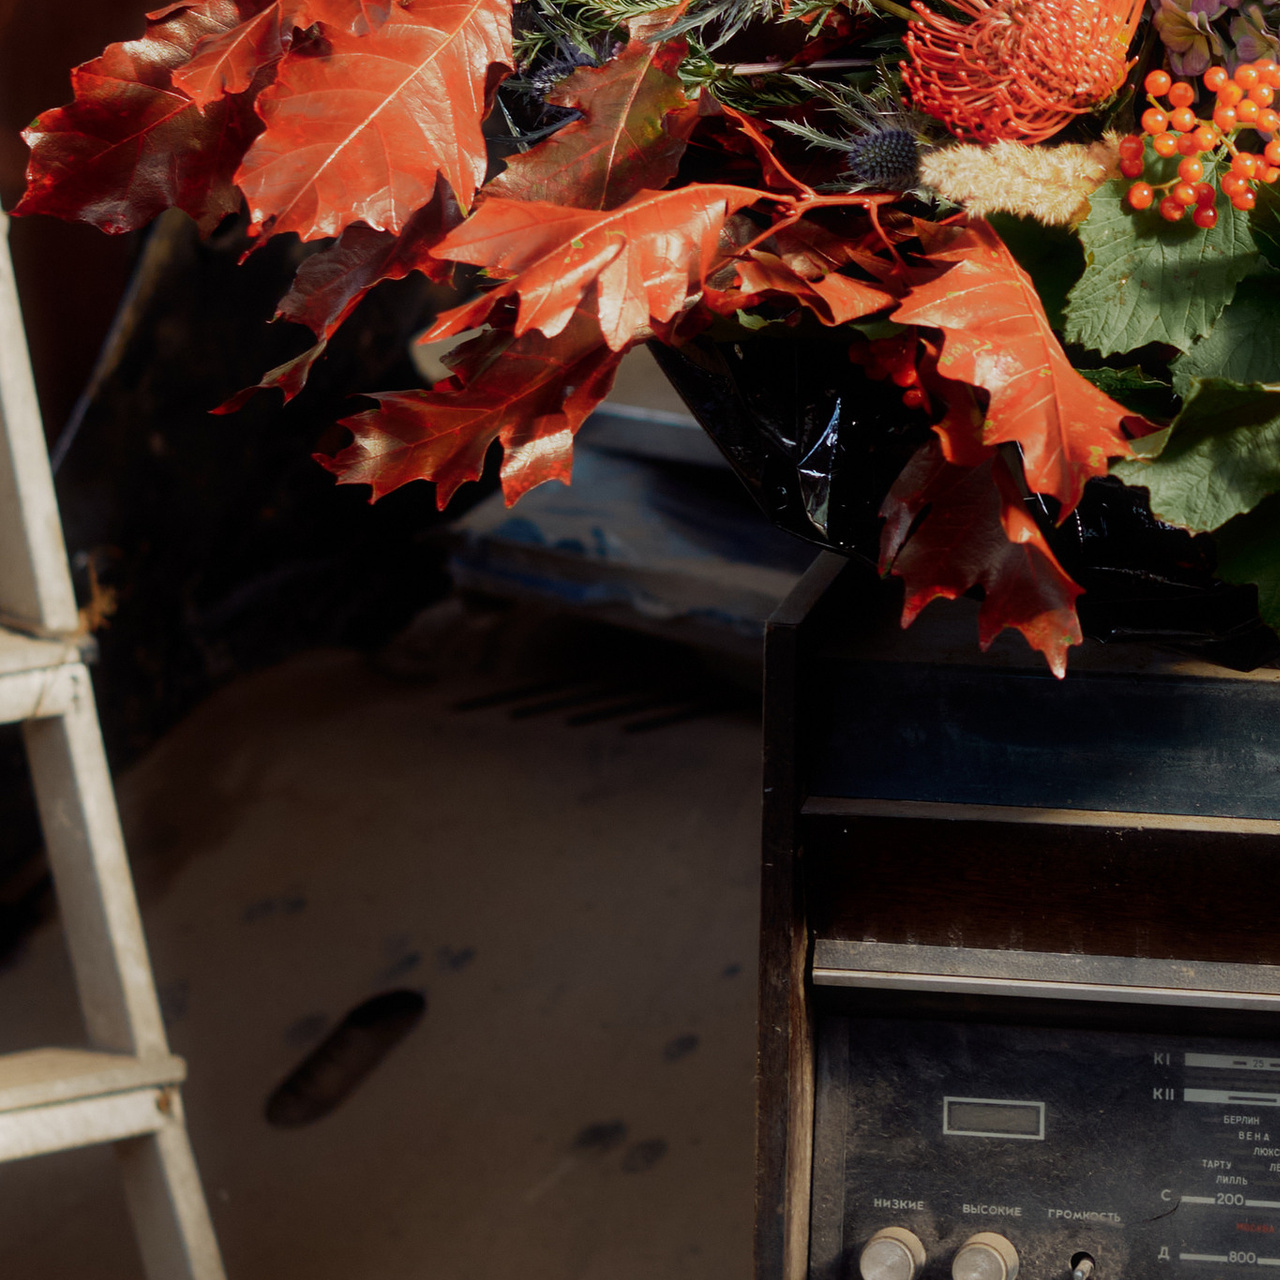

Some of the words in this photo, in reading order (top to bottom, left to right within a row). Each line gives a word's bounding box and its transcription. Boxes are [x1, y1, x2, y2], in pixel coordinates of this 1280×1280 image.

[1252, 1059, 1264, 1068] 25
[1223, 1115, 1260, 1125] БЕРЛИН
[1238, 1131, 1270, 1141] ВЕНА
[1202, 1159, 1232, 1170] ТАРТУ
[1215, 1175, 1248, 1186] ЛИЛЛЬ
[1217, 1192, 1244, 1206] 200
[873, 1198, 924, 1210] НИЗКИЕ
[962, 1204, 1022, 1217] ВЫСОКИЕ
[1048, 1209, 1121, 1223] ГРОМКОСТЬ
[1157, 1246, 1170, 1261] Д
[1228, 1251, 1256, 1264] 800
